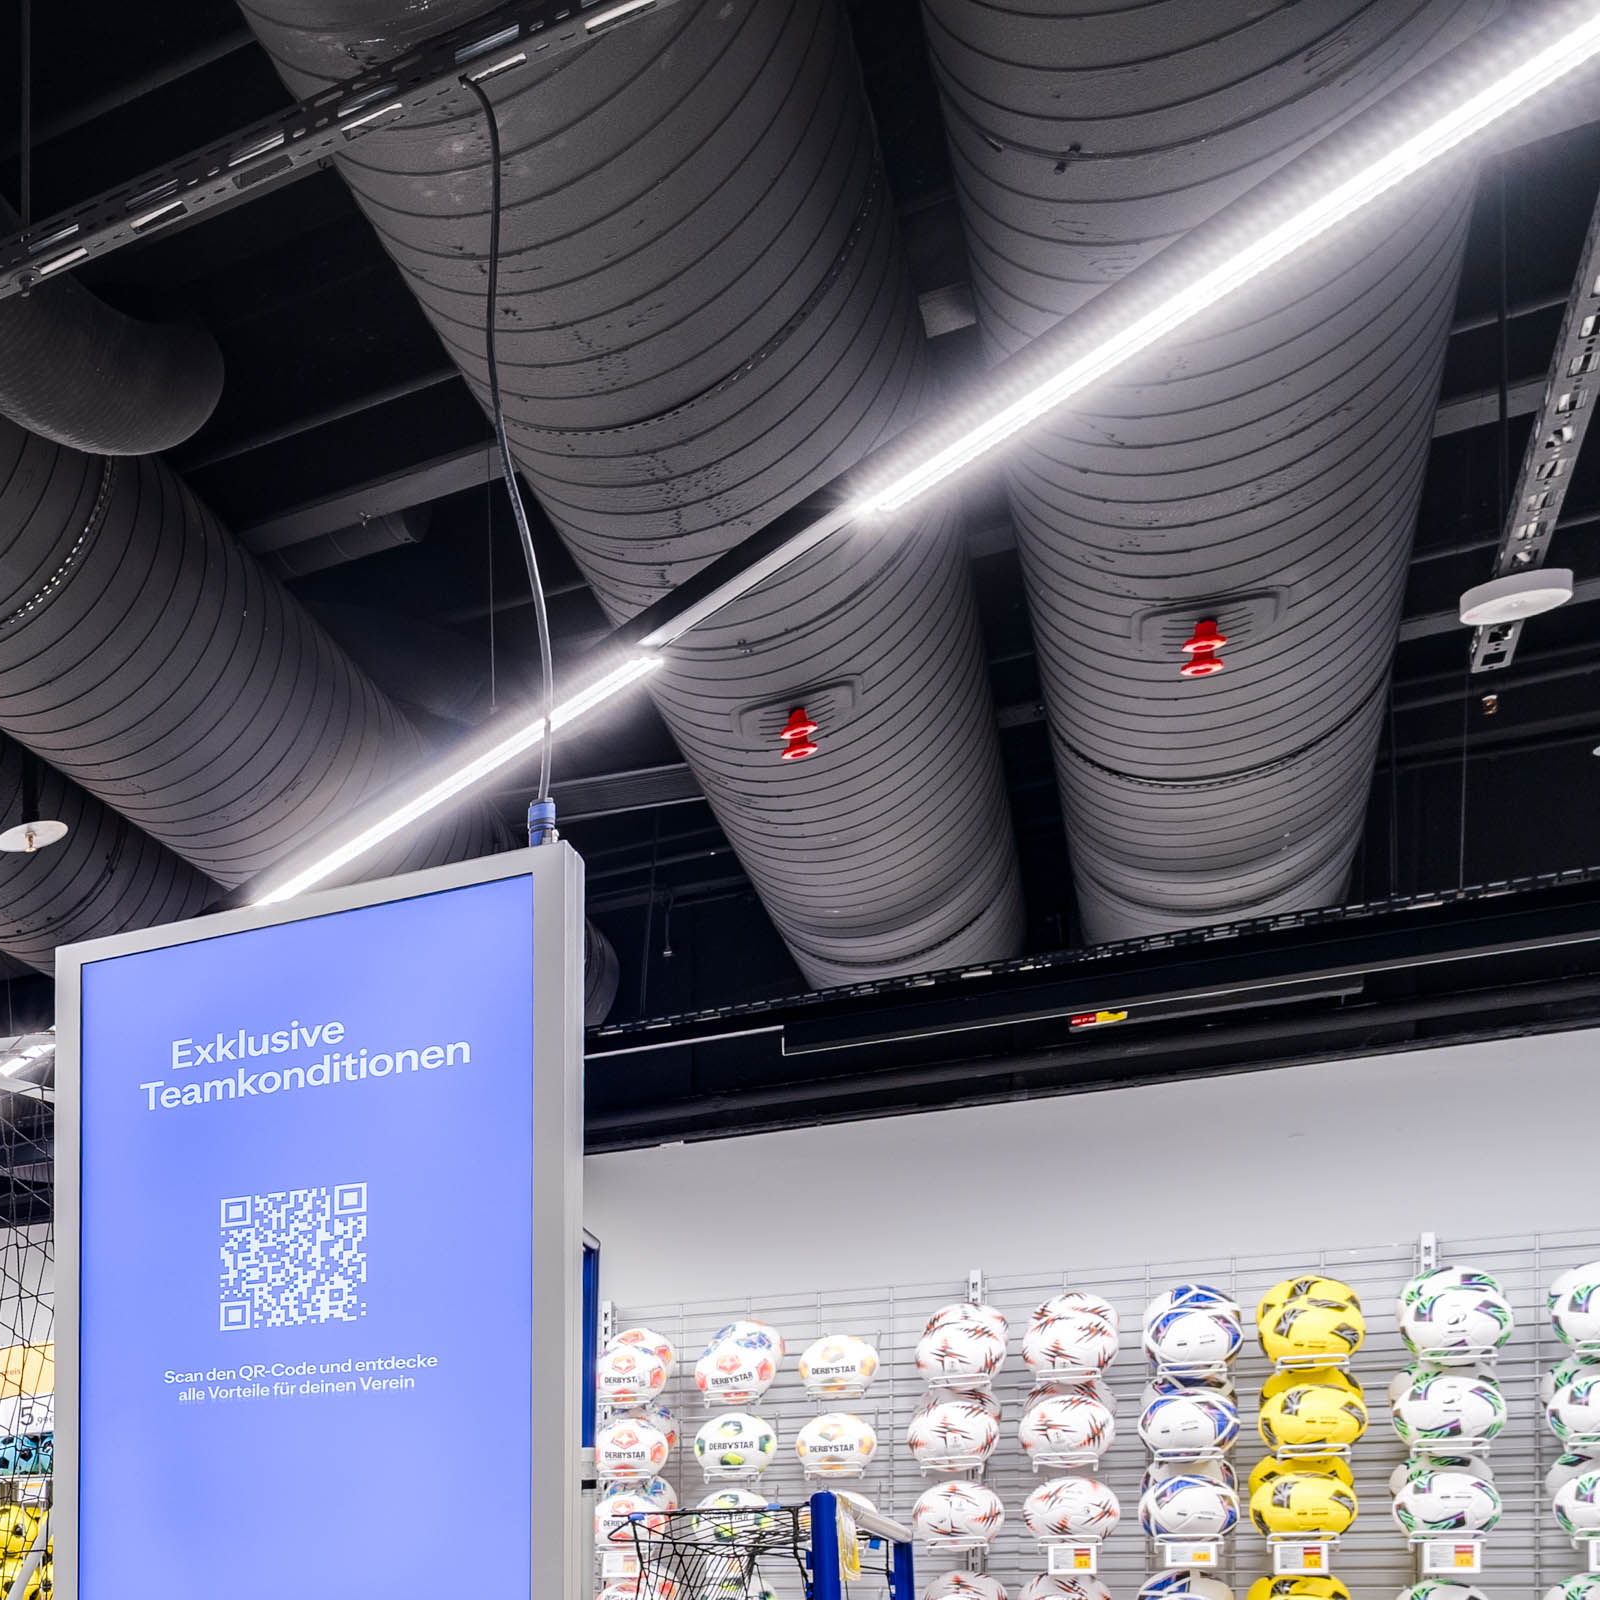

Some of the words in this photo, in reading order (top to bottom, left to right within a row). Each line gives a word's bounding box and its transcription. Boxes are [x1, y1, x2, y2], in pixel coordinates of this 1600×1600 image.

[172, 1020, 345, 1070] Exklusive
[140, 1041, 470, 1110] Teamkonditionen
[164, 1370, 203, 1384] Scan
[207, 1368, 236, 1382] den
[239, 1362, 317, 1380] QR-Code
[320, 1359, 352, 1374] und
[355, 1354, 438, 1372] entdecke
[811, 1365, 857, 1376] DERBYSTAR
[604, 1376, 646, 1386] DERBYST
[711, 1371, 754, 1385] DERBYSTAR
[179, 1387, 205, 1401] alle
[209, 1383, 270, 1400] Vorteile
[273, 1383, 296, 1396] für
[299, 1379, 356, 1394] deinen
[360, 1375, 415, 1390] Verein
[708, 1441, 754, 1450] DERBYSTAR
[809, 1443, 855, 1454] DERBYSTAR
[604, 1450, 646, 1460] DERBYSTAR
